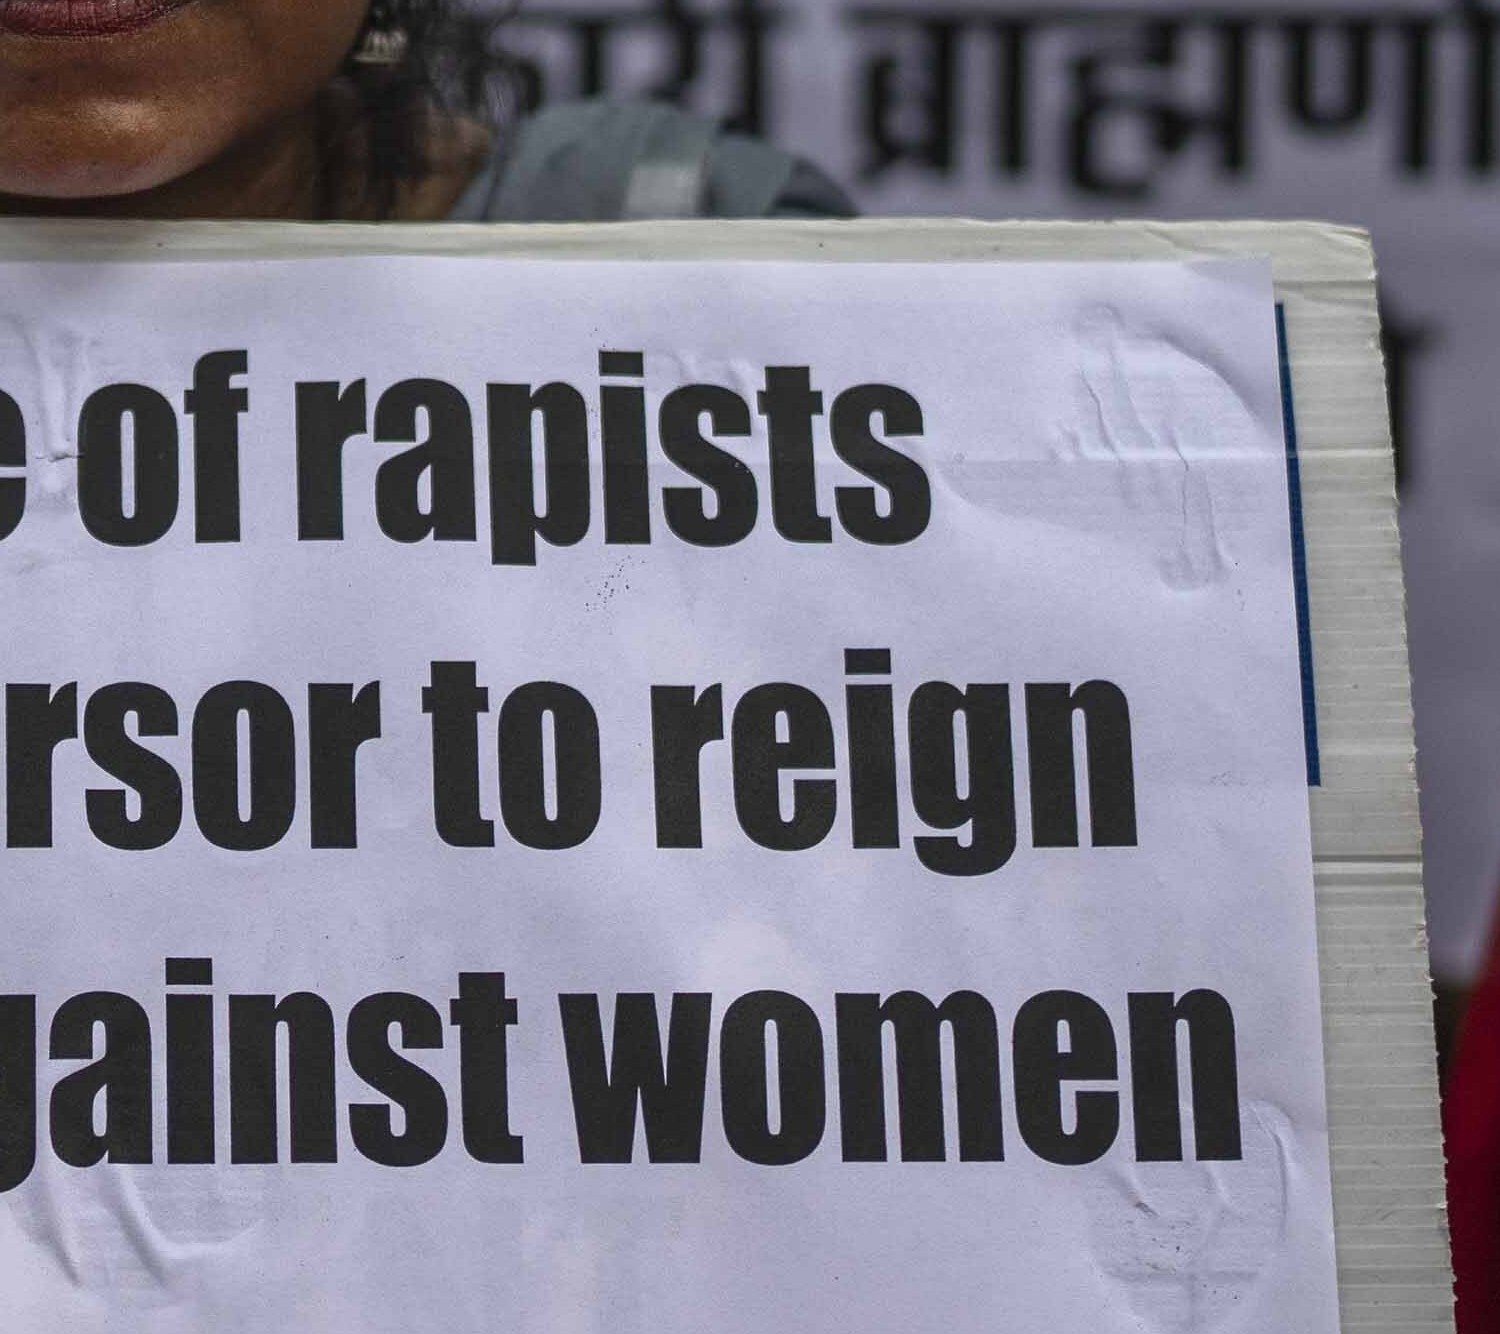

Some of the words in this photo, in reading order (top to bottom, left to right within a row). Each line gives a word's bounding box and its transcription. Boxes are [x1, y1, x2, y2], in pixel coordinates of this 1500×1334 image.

[76, 349, 249, 548] of
[294, 351, 933, 566] rapists
[421, 660, 602, 852] to
[650, 647, 1139, 877] reign
[556, 988, 1244, 1167] women
